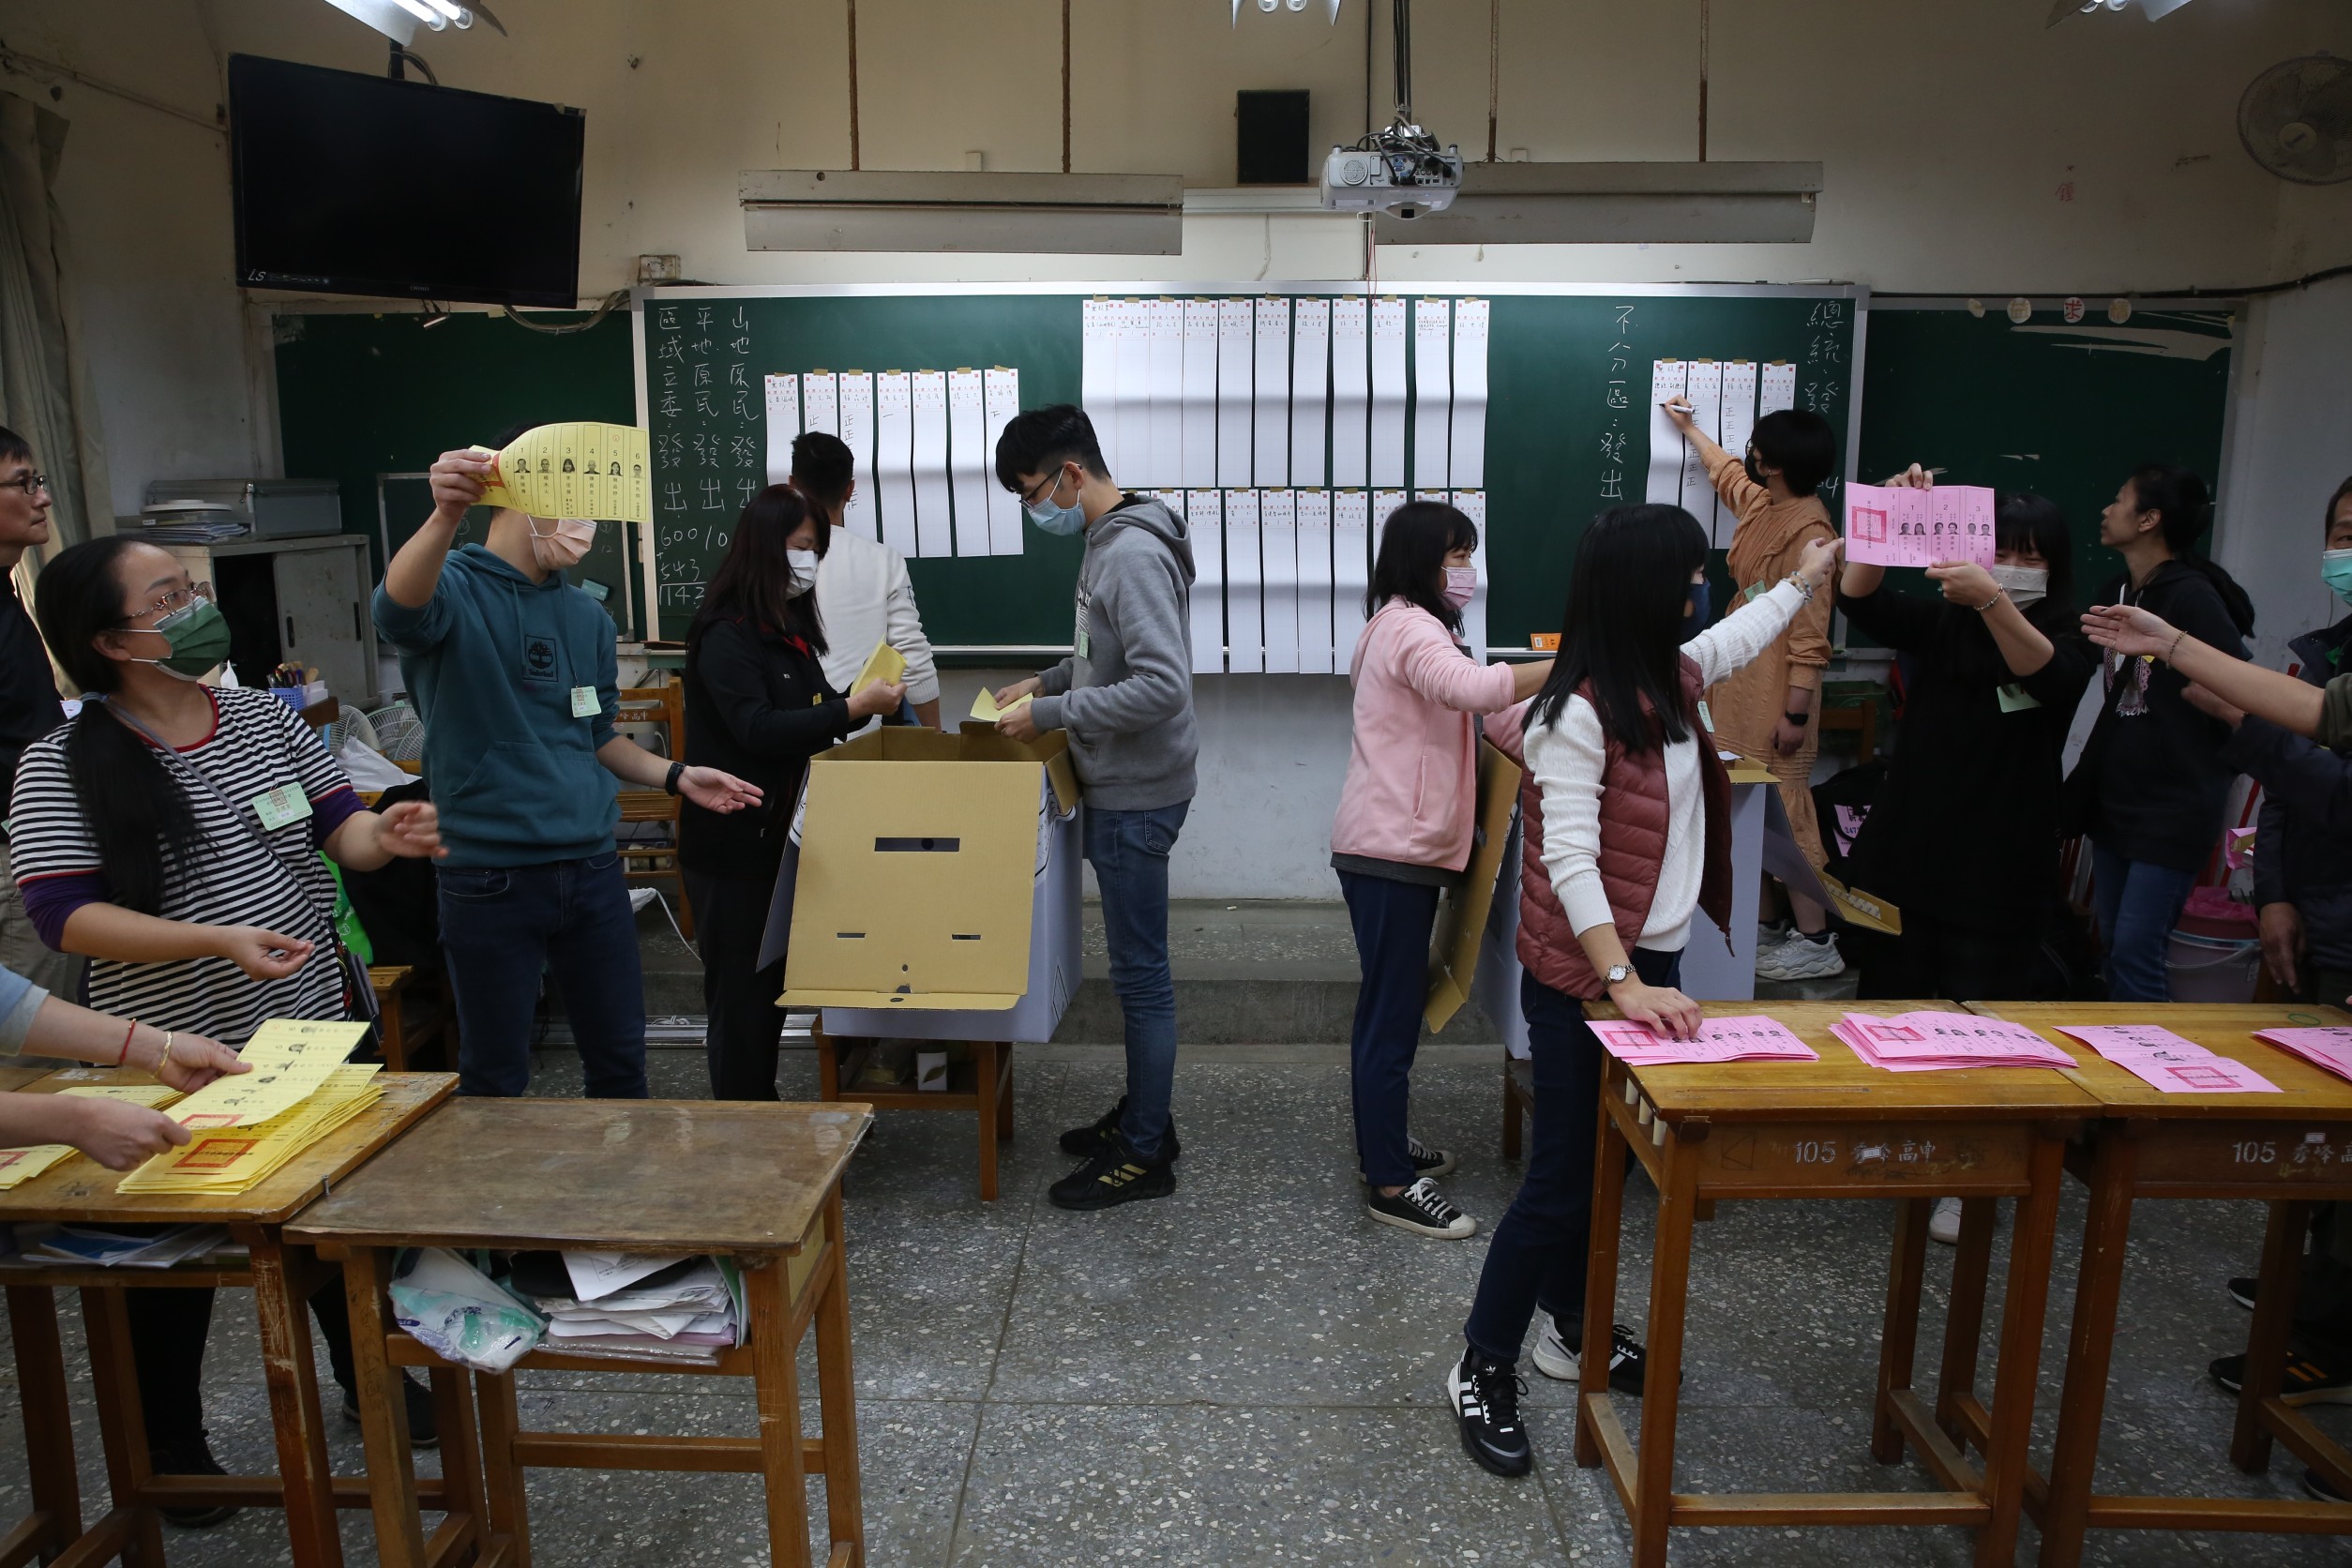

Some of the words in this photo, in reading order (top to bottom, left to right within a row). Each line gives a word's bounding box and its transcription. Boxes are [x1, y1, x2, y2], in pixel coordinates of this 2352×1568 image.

[2064, 298, 2083, 321] 求
[660, 525, 698, 547] 600
[1795, 1140, 1837, 1164] 105
[2232, 1141, 2277, 1164] 105
